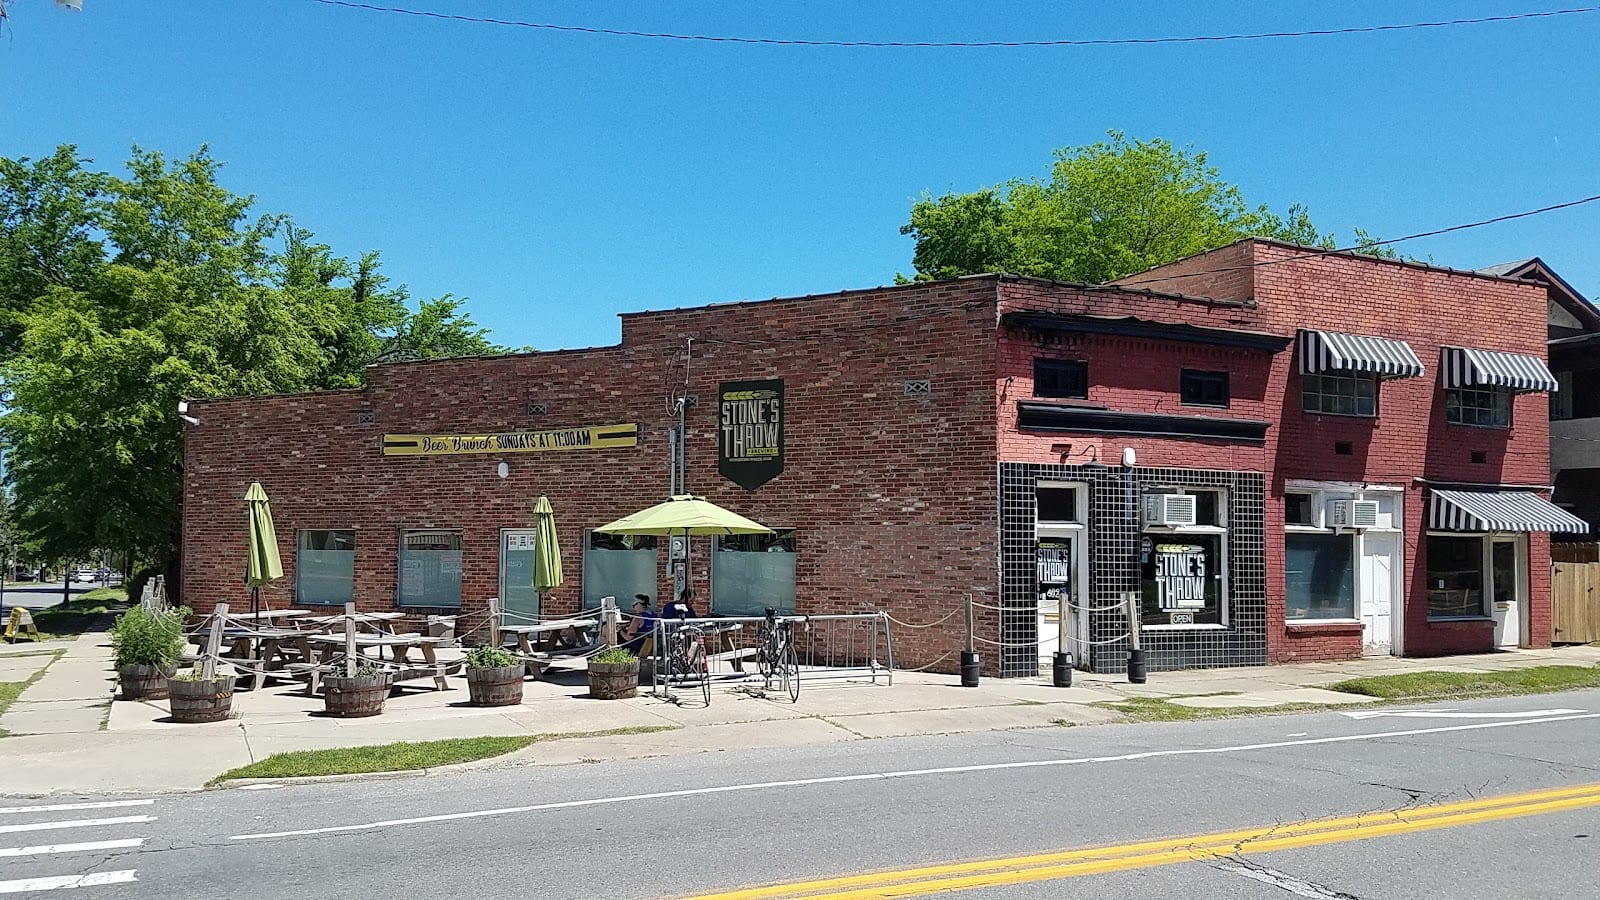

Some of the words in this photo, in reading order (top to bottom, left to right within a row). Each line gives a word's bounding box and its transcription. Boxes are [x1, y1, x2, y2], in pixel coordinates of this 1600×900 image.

[722, 399, 779, 424] STONE'S
[422, 436, 448, 452] Beer
[452, 434, 493, 451] Brunch
[496, 433, 536, 448] SUNDAYS
[540, 433, 550, 447] AT
[553, 430, 591, 446] 11:00AM
[722, 423, 779, 457] THROW
[1038, 549, 1068, 562] STONE'S
[1155, 553, 1205, 576] STONE'S
[1038, 562, 1068, 581] THROW
[1155, 575, 1205, 608] THROW
[1173, 614, 1191, 624] OPEN
